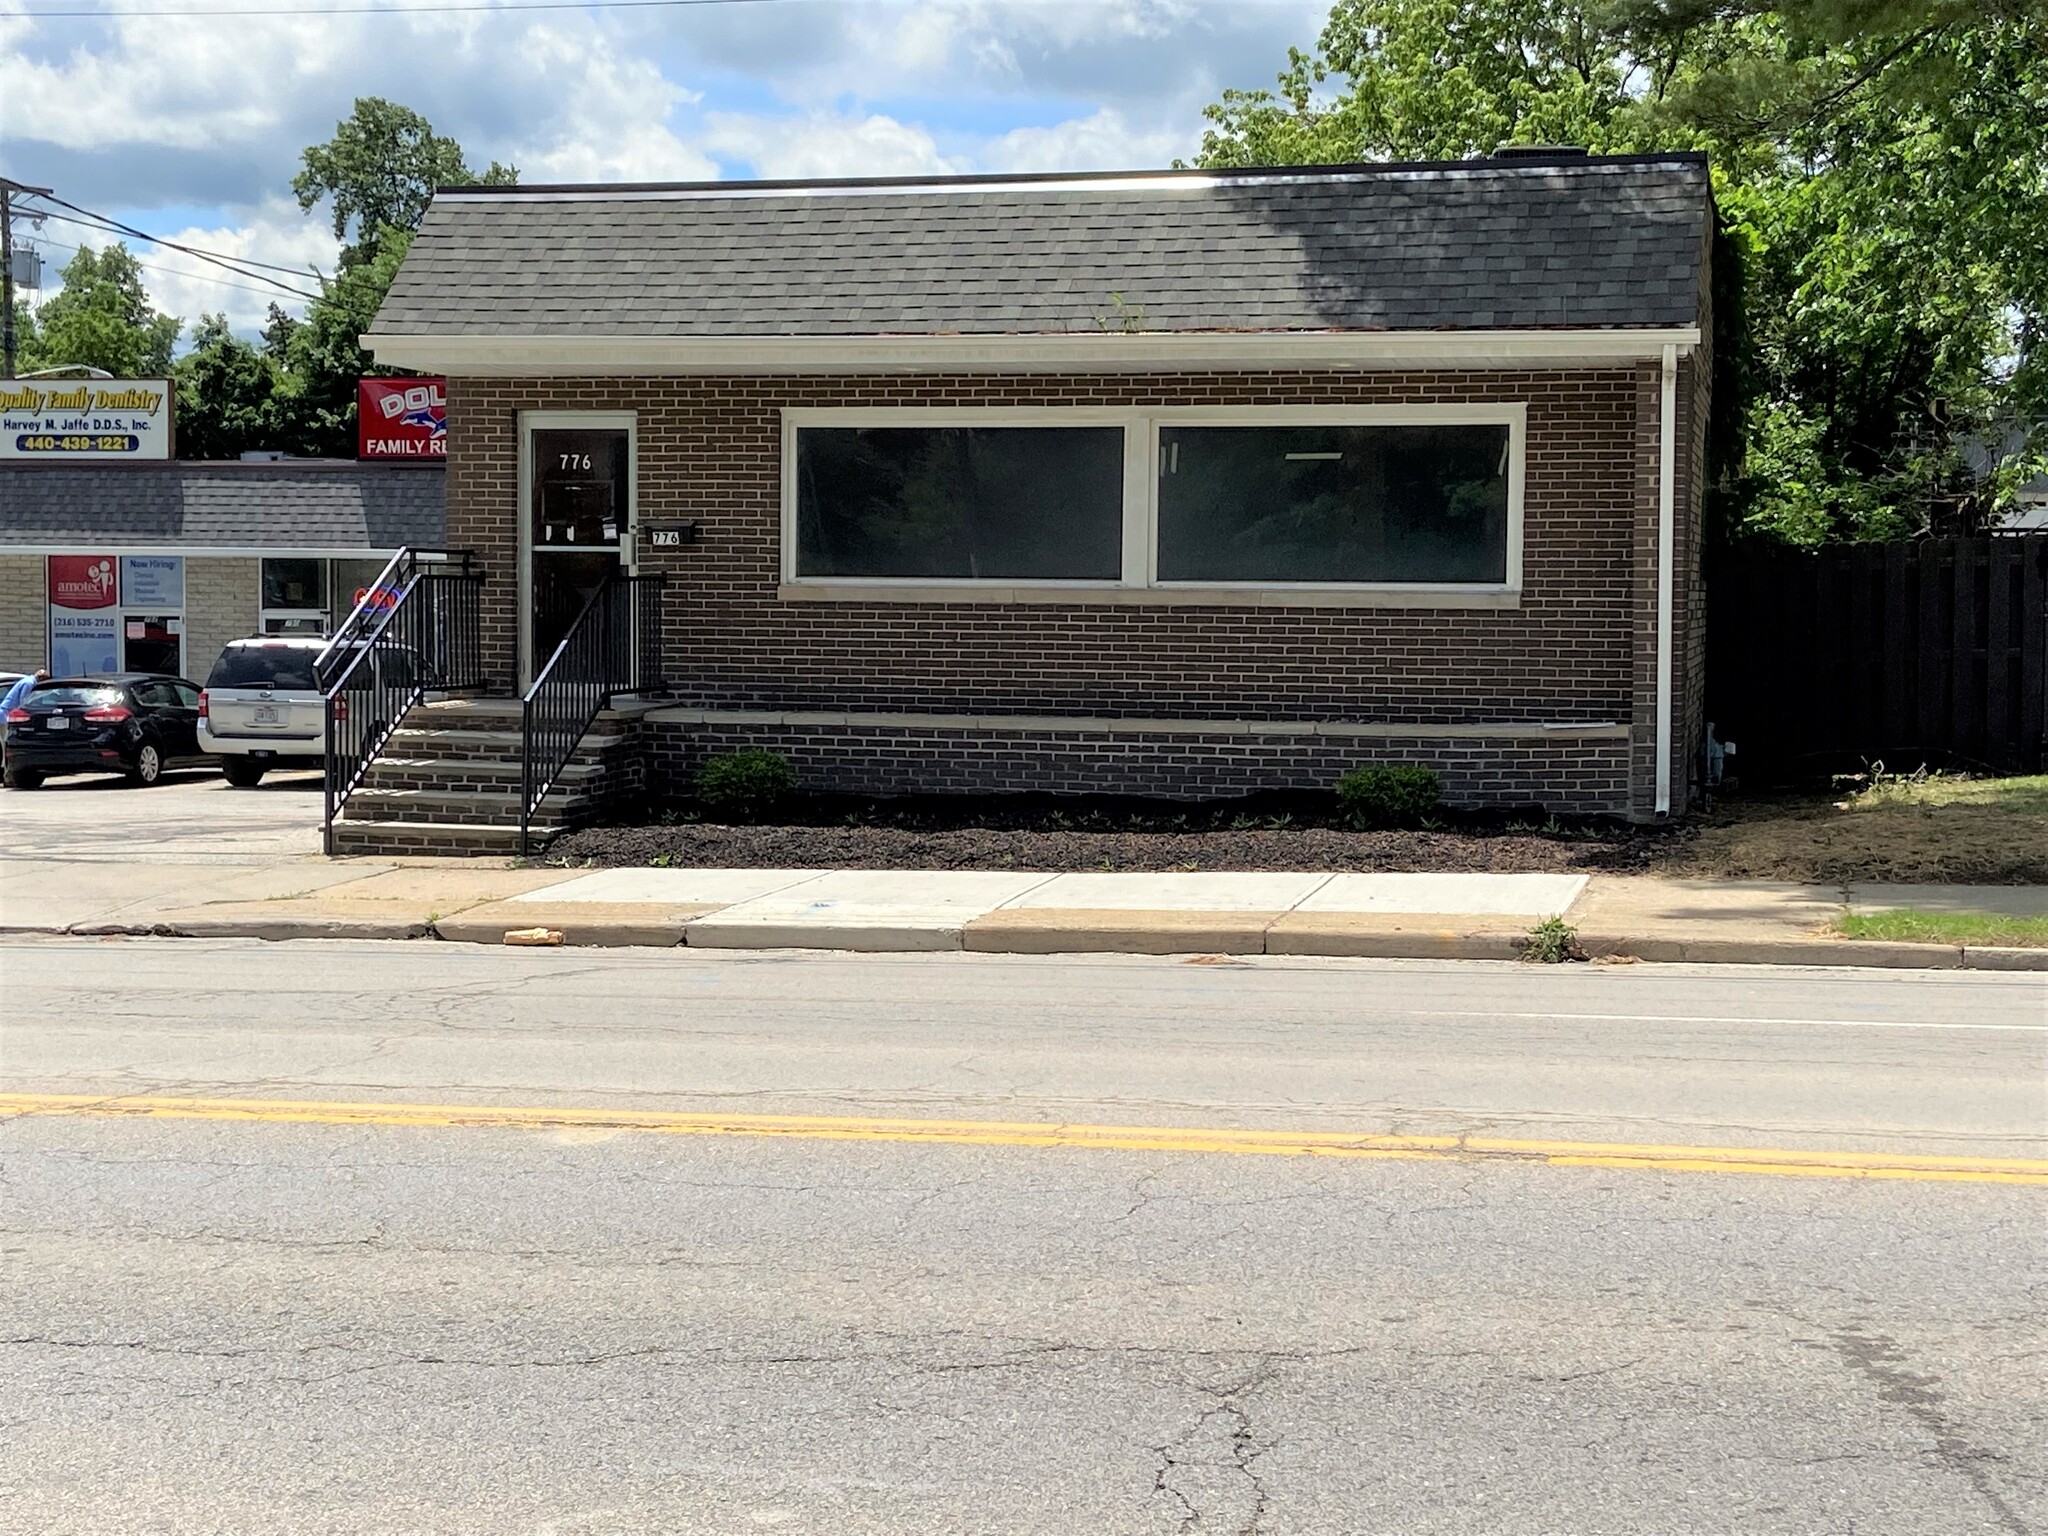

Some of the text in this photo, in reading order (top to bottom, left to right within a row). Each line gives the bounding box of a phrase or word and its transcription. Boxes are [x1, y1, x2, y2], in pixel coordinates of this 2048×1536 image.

[0, 386, 163, 416] Quality Family Dentistry
[3, 419, 41, 432] Harvey
[45, 419, 57, 430] M.
[61, 419, 89, 430] Jaffe
[132, 419, 151, 431] Inc.
[25, 437, 130, 450] 440-439-1221
[366, 439, 425, 454] FAMILY
[560, 454, 591, 470] 776
[654, 533, 678, 544] 776
[57, 581, 101, 593] amotec
[54, 617, 75, 627] (216)
